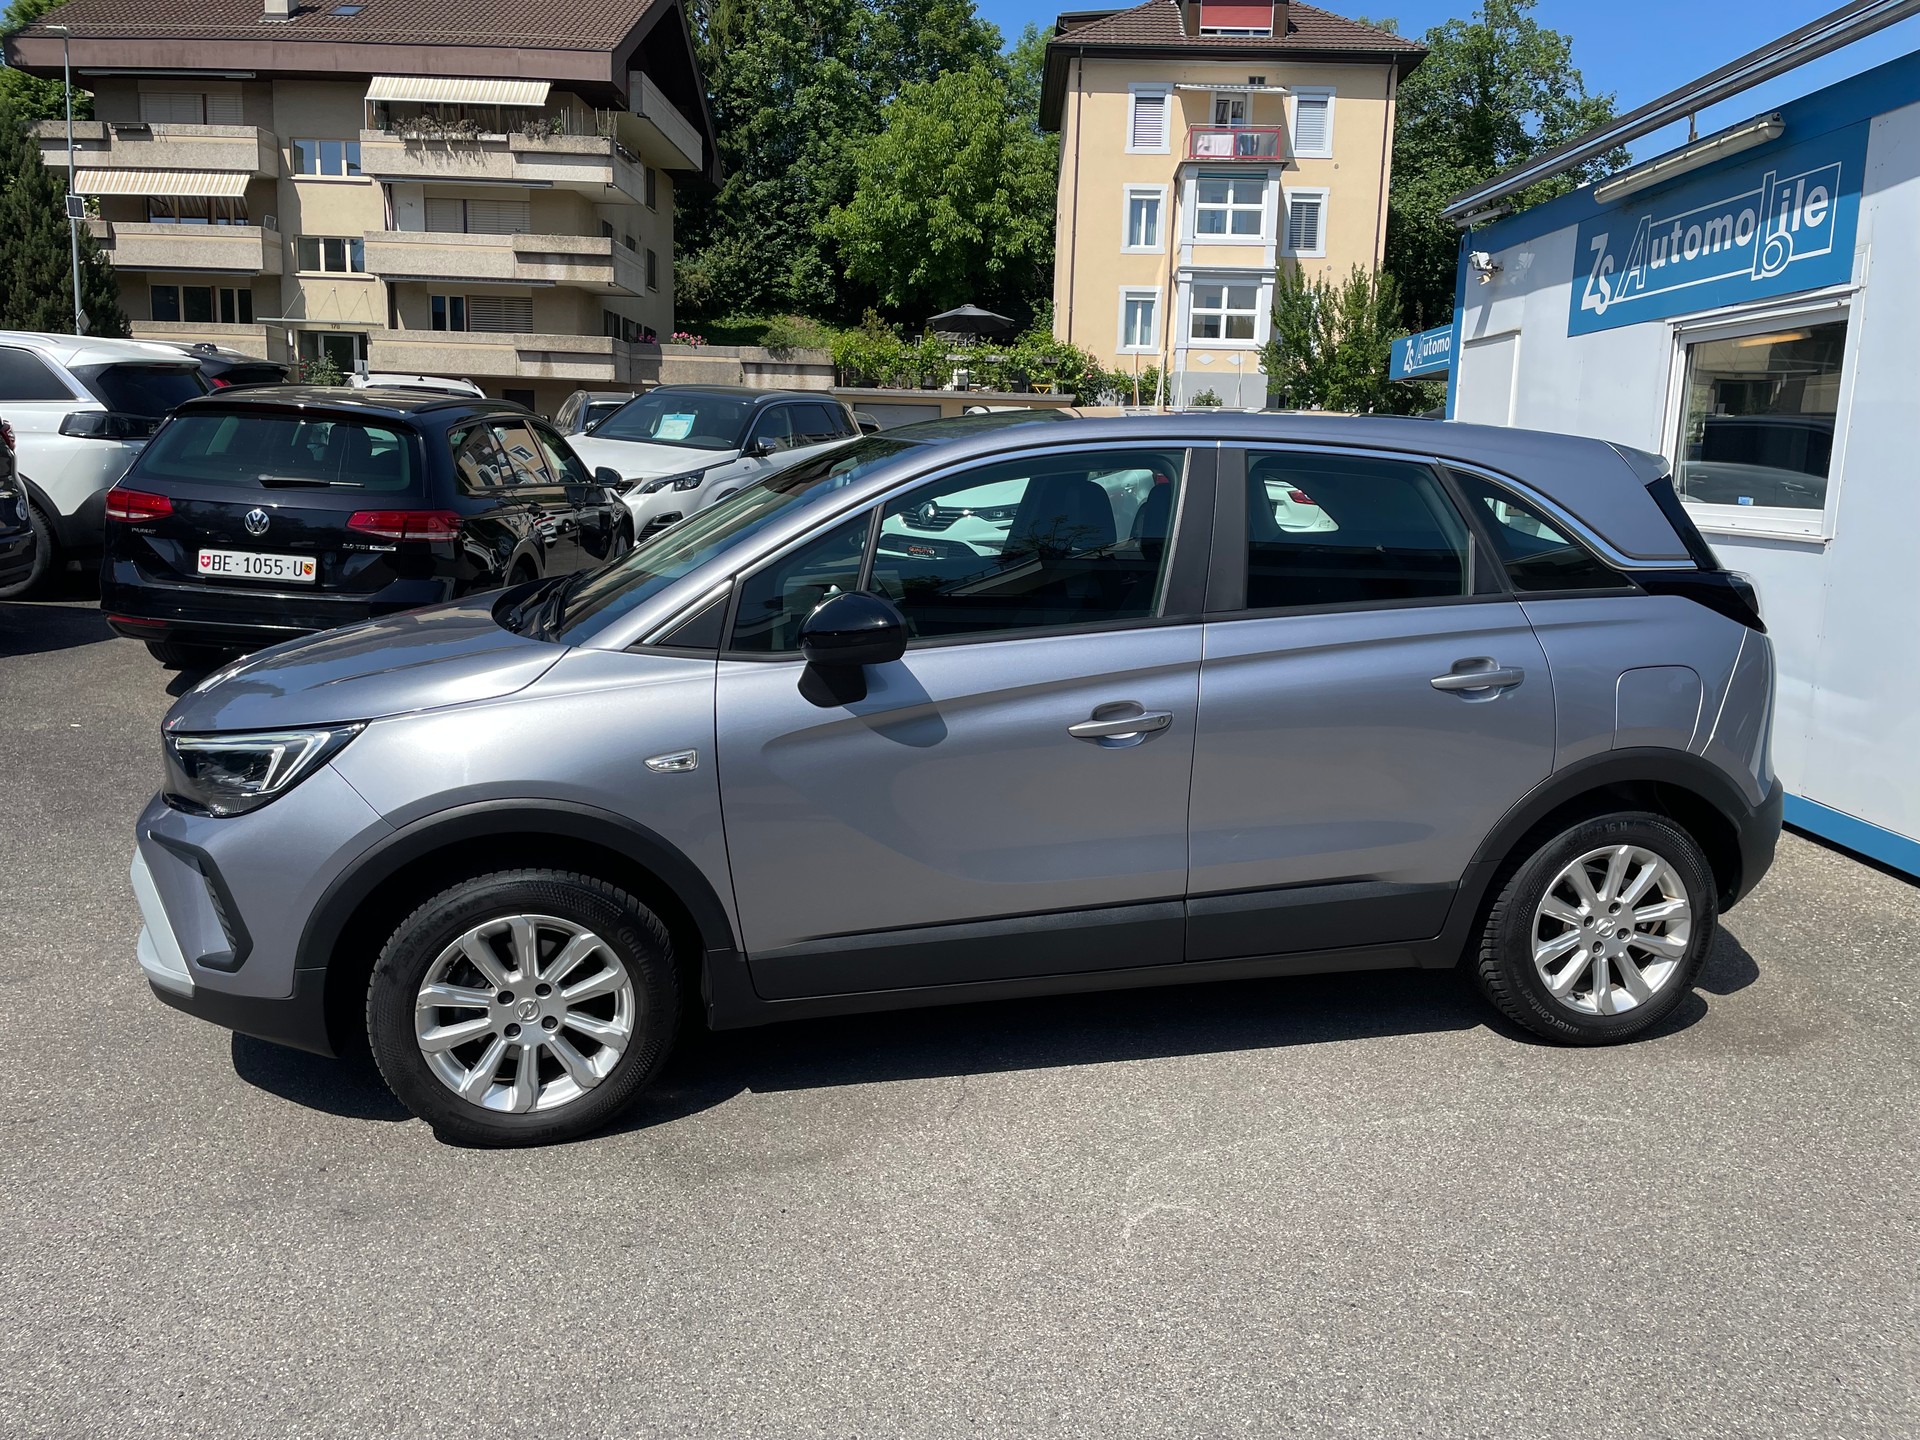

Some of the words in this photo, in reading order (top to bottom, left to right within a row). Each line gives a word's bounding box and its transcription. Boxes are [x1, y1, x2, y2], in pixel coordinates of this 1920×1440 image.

[1615, 170, 1830, 302] Automobile
[1414, 326, 1453, 367] Automo
[212, 554, 232, 572] BE
[244, 557, 283, 575] 1055
[293, 560, 303, 577] U
